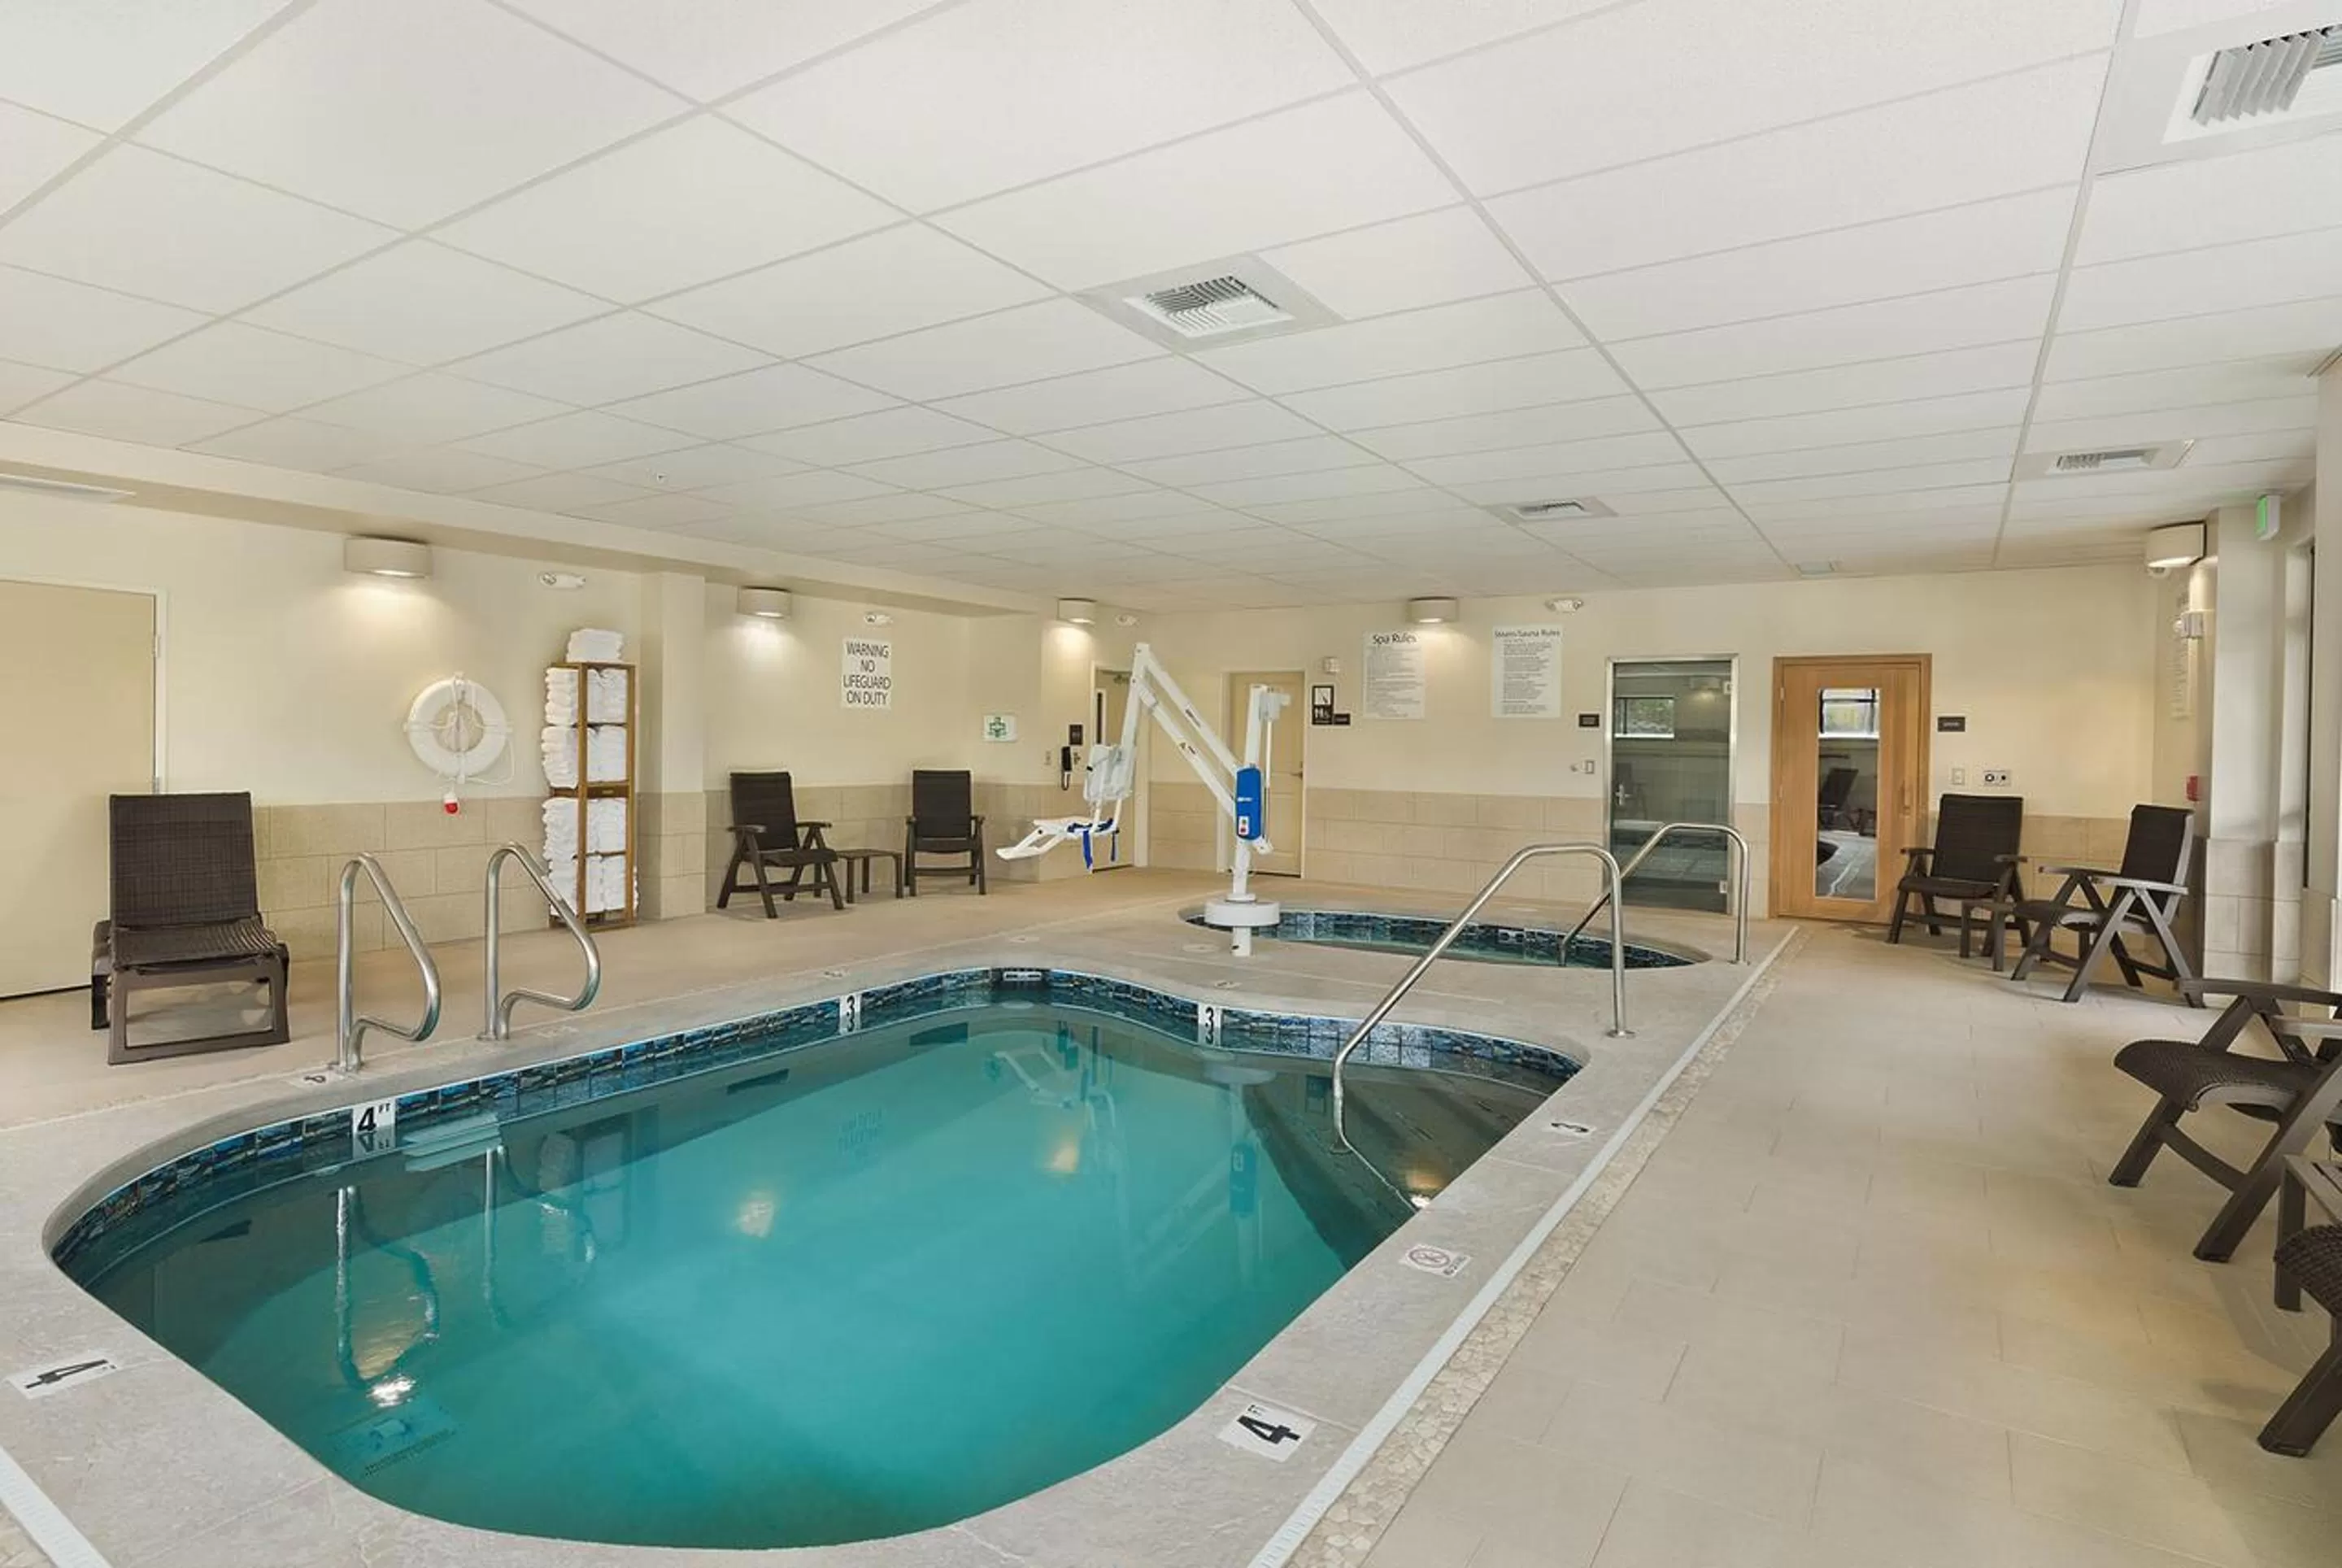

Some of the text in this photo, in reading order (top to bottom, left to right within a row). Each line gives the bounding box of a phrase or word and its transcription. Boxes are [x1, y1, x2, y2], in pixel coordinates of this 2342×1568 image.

[1371, 633, 1417, 647] Spa Rules
[846, 641, 890, 659] WARNING
[860, 660, 876, 673] NO
[842, 674, 892, 690] LIFEGUARD
[847, 690, 888, 705] ON DUTY
[847, 995, 855, 1017] 3
[1205, 1007, 1215, 1028] 3
[358, 1106, 377, 1131] 4
[1236, 1414, 1301, 1445] 4
